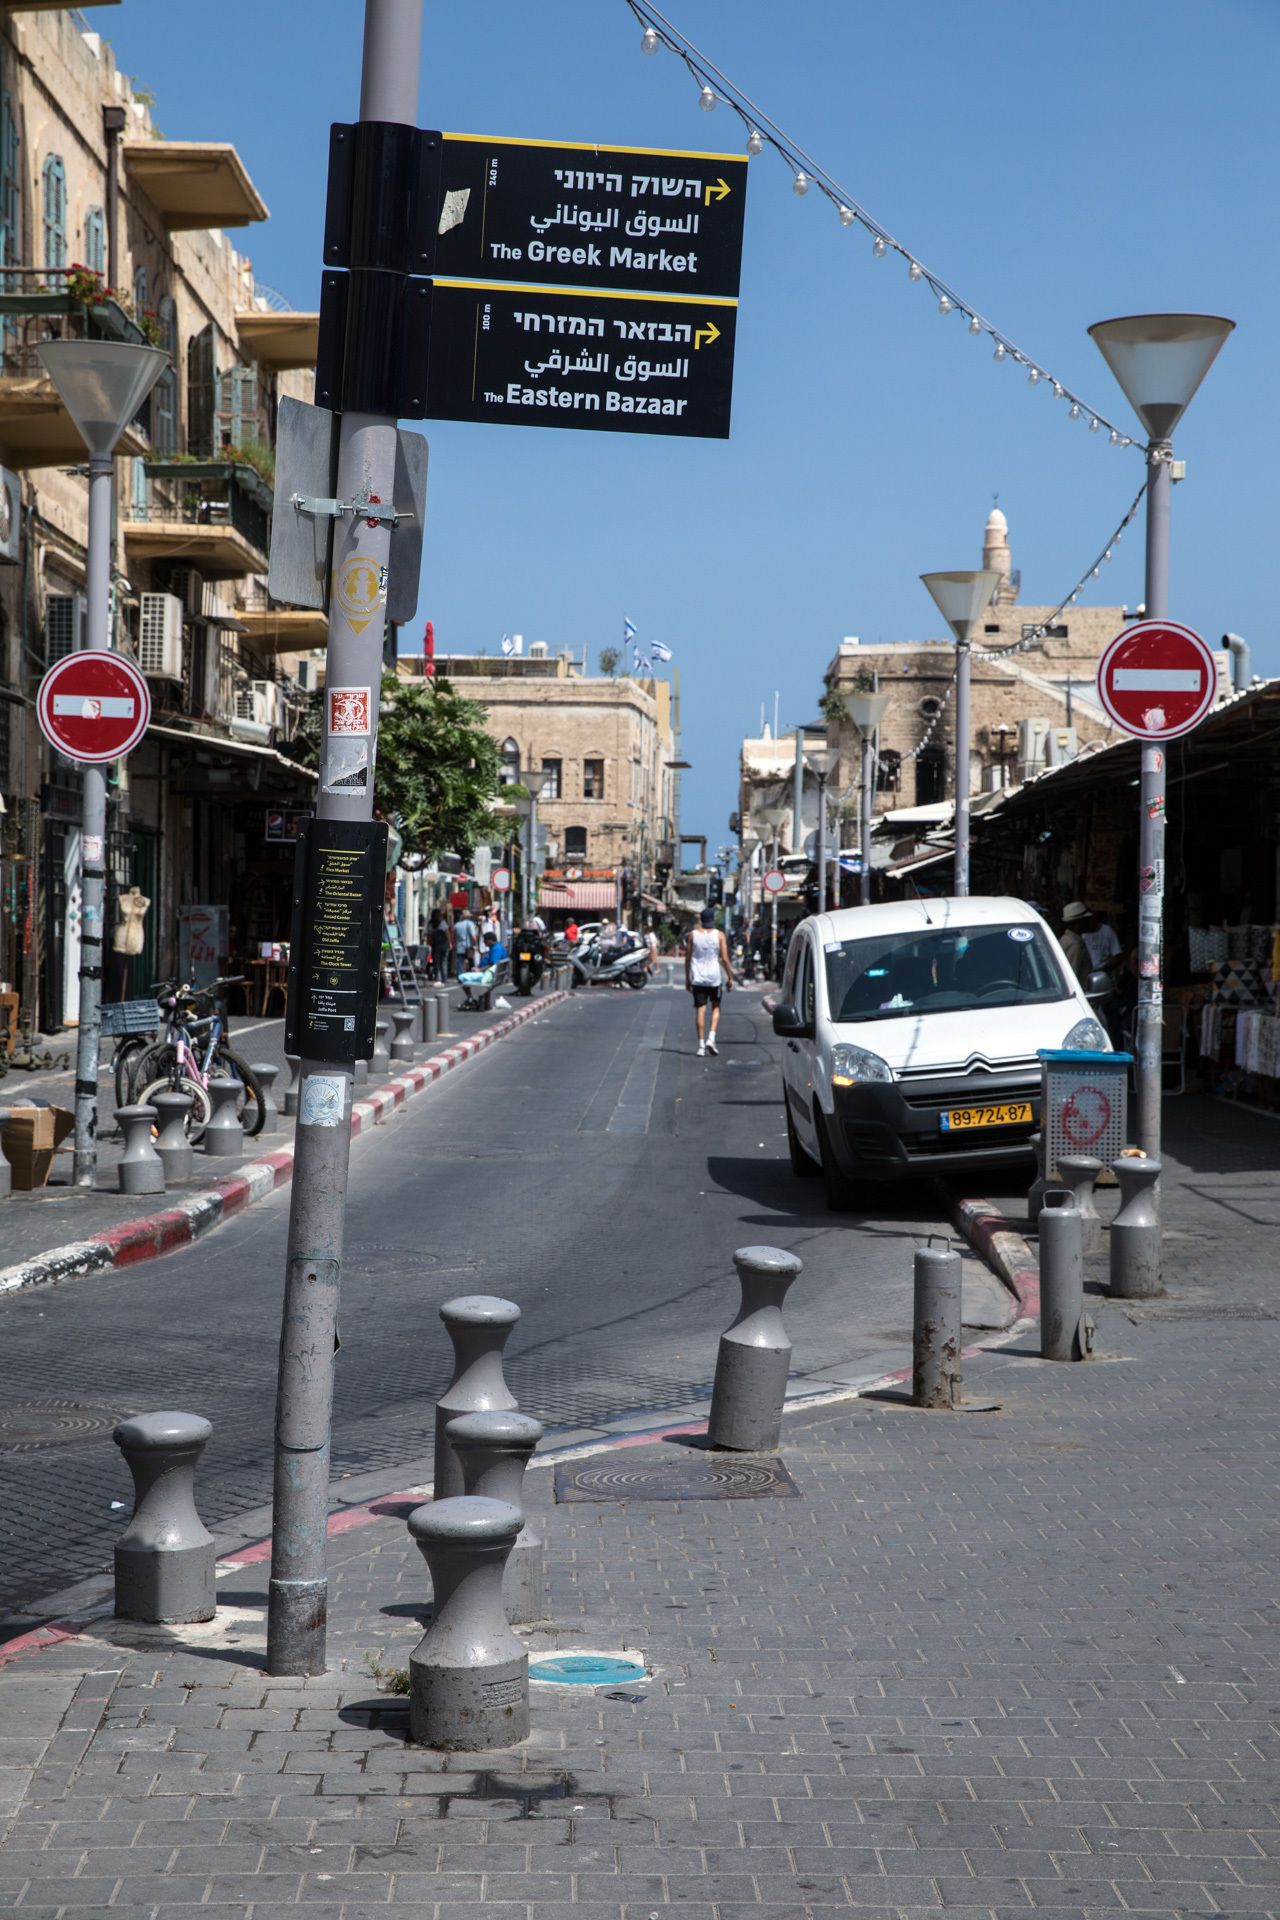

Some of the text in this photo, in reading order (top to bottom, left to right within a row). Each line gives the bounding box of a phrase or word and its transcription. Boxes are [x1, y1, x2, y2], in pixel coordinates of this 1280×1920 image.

[488, 158, 498, 186] 240 m
[554, 168, 702, 199] השוק היווני
[530, 203, 699, 237] السوق اليوناني
[490, 240, 698, 273] The Greek Market
[482, 303, 491, 331] 100 m
[513, 311, 692, 343] הבזאר המזרחי
[524, 348, 689, 382] السوق الشرقي
[483, 383, 688, 416] The Eastern Bazaar
